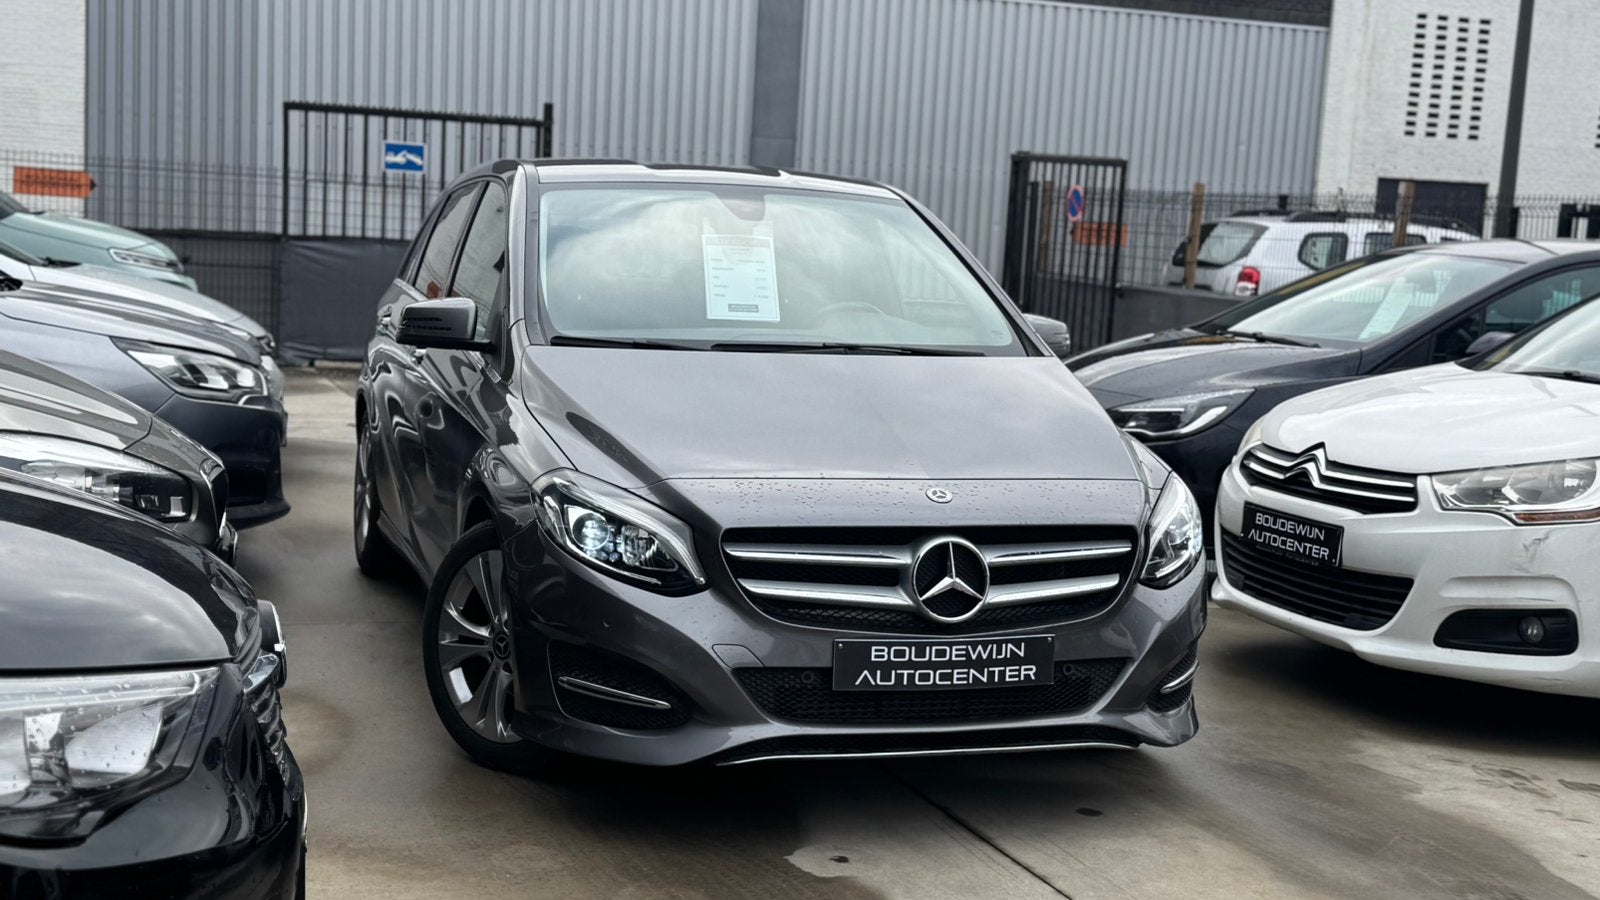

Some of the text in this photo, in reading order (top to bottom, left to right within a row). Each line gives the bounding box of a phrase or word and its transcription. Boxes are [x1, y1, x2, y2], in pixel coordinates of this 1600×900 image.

[1255, 512, 1325, 541] BOUDEWIJN
[1248, 528, 1330, 561] AUTOCENTER
[871, 642, 1025, 661] BOUDEWIJN
[854, 665, 1037, 686] AUTOCENTER
